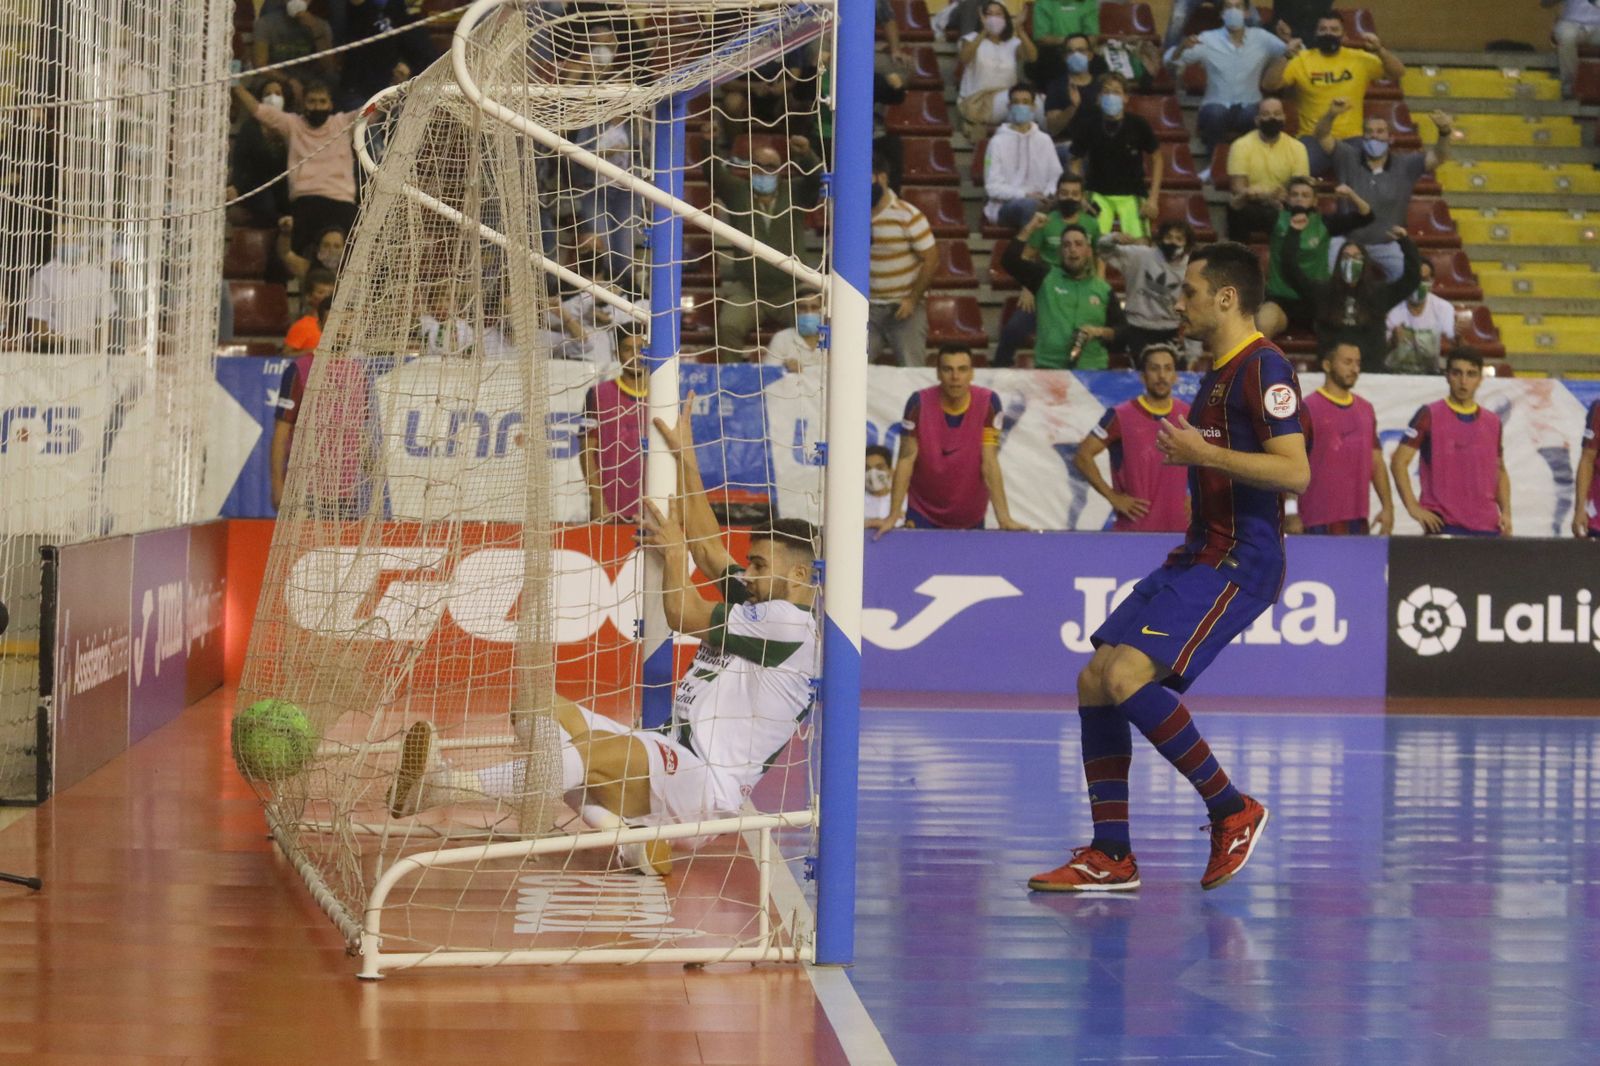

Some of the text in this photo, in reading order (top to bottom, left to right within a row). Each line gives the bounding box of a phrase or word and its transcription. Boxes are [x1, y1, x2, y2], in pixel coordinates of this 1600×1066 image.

[1311, 70, 1352, 84] FILA
[1061, 575, 1347, 654] Ja
[1476, 588, 1600, 654] LaLi
